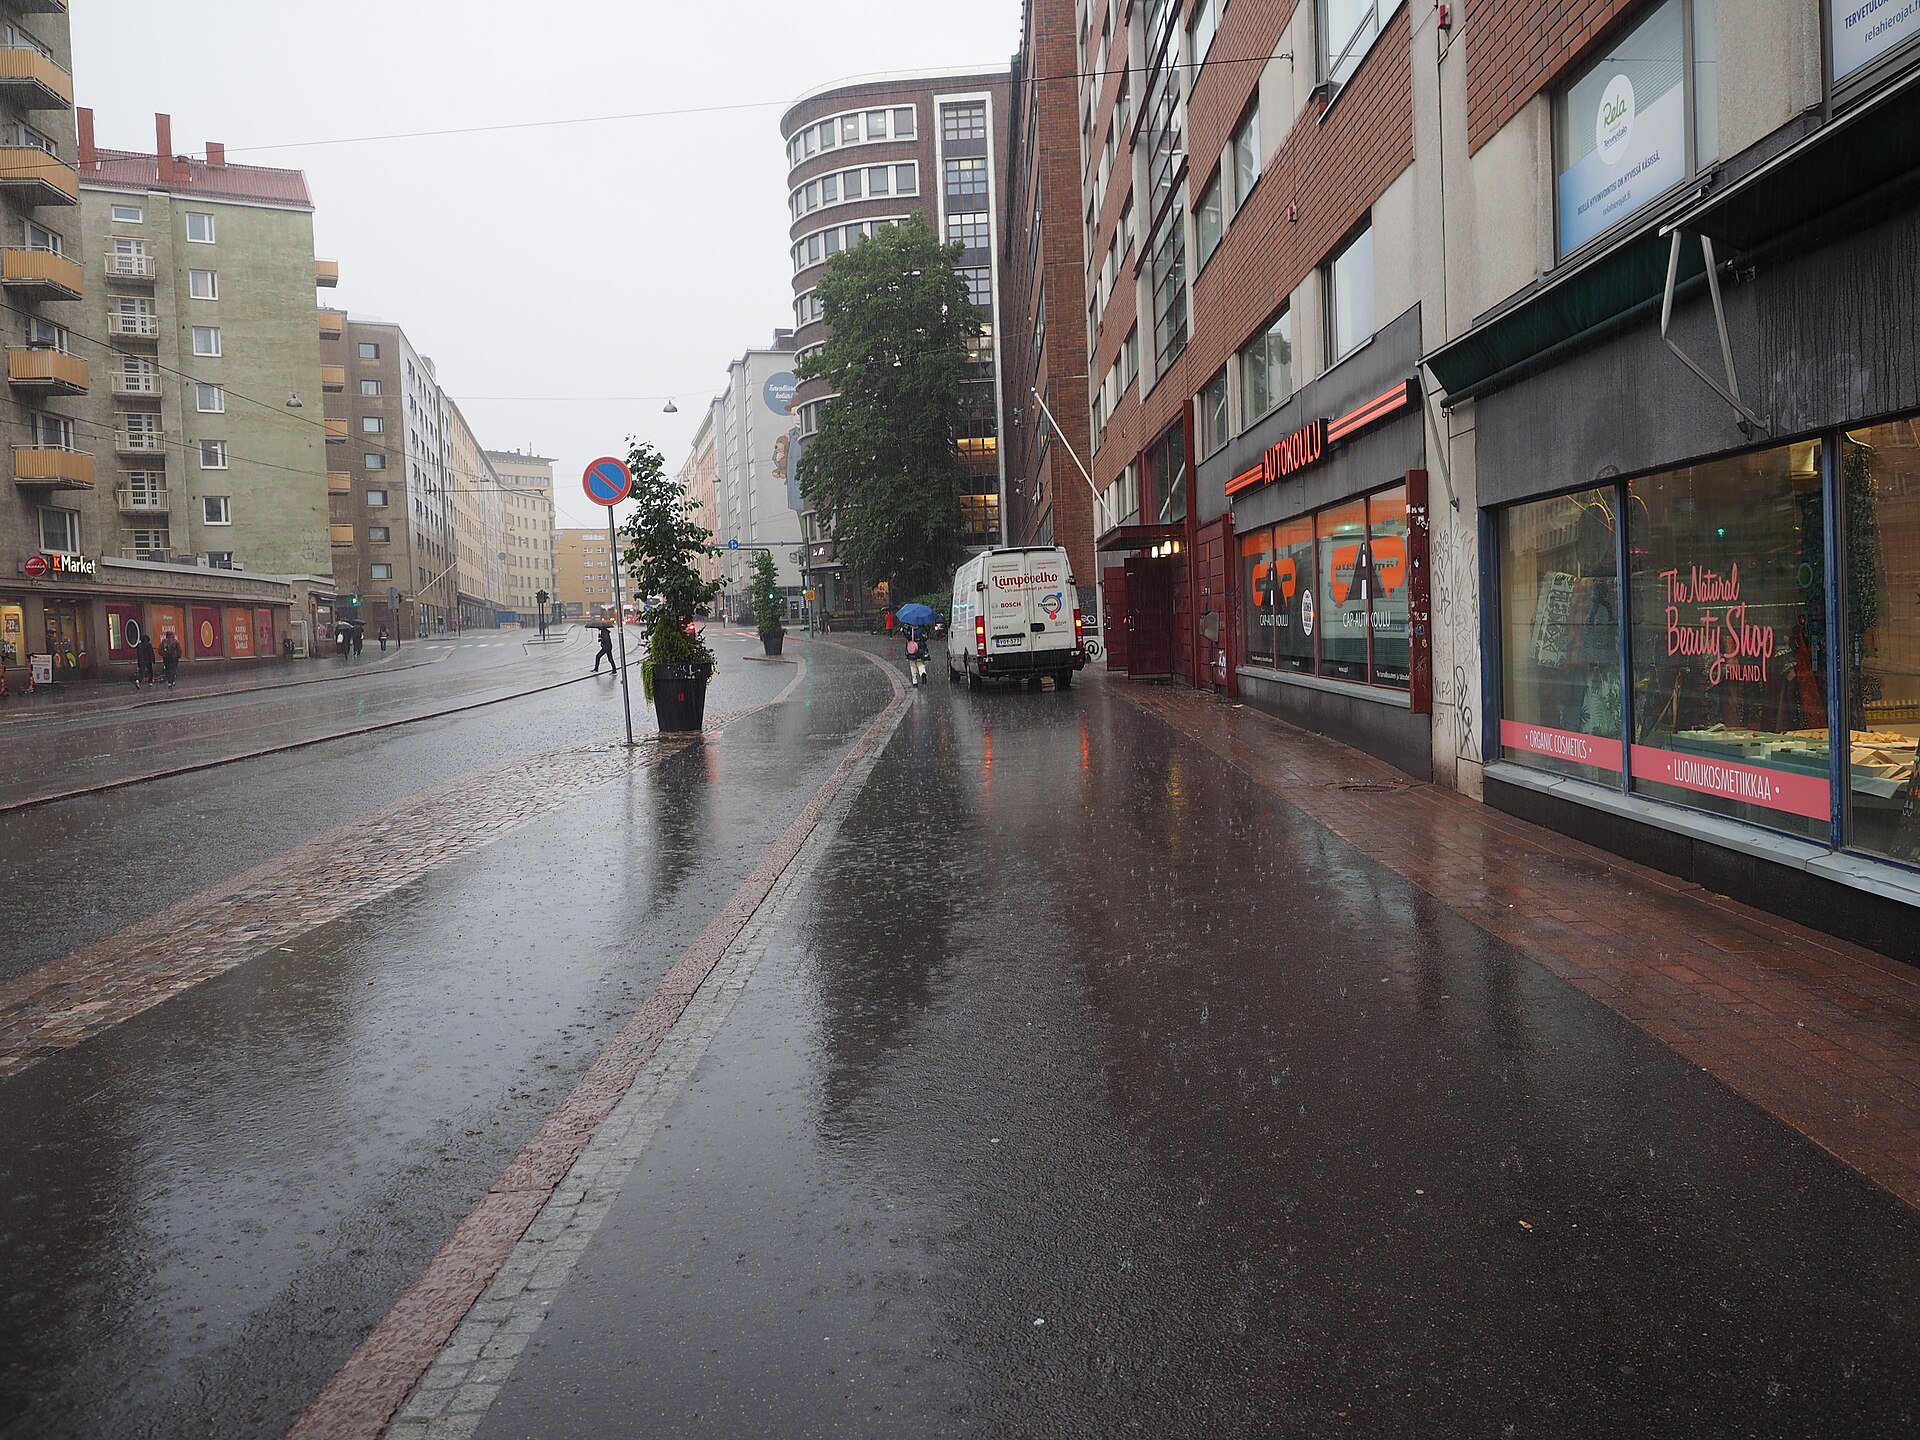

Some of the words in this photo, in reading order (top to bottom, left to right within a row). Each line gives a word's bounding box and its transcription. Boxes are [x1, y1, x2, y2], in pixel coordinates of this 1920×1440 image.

[1602, 94, 1627, 128] Rela
[1603, 126, 1628, 148] Terveystalo
[1602, 190, 1632, 217] relahierojat.fi
[1264, 418, 1322, 485] AUTOKOULU
[61, 554, 97, 574] Market
[992, 572, 1058, 590] Lämpövelho
[1659, 568, 1687, 604] The
[1687, 562, 1740, 604] Natural
[1000, 601, 1021, 609] BOSCH
[1665, 605, 1725, 686] Beauty
[1723, 601, 1774, 683] Shop
[1725, 663, 1761, 682] FINLAND
[1529, 730, 1553, 752] ORGANIC
[1553, 734, 1588, 760] COSMETICS
[1673, 758, 1772, 801] LUOMUKOSMETIIKKAA
